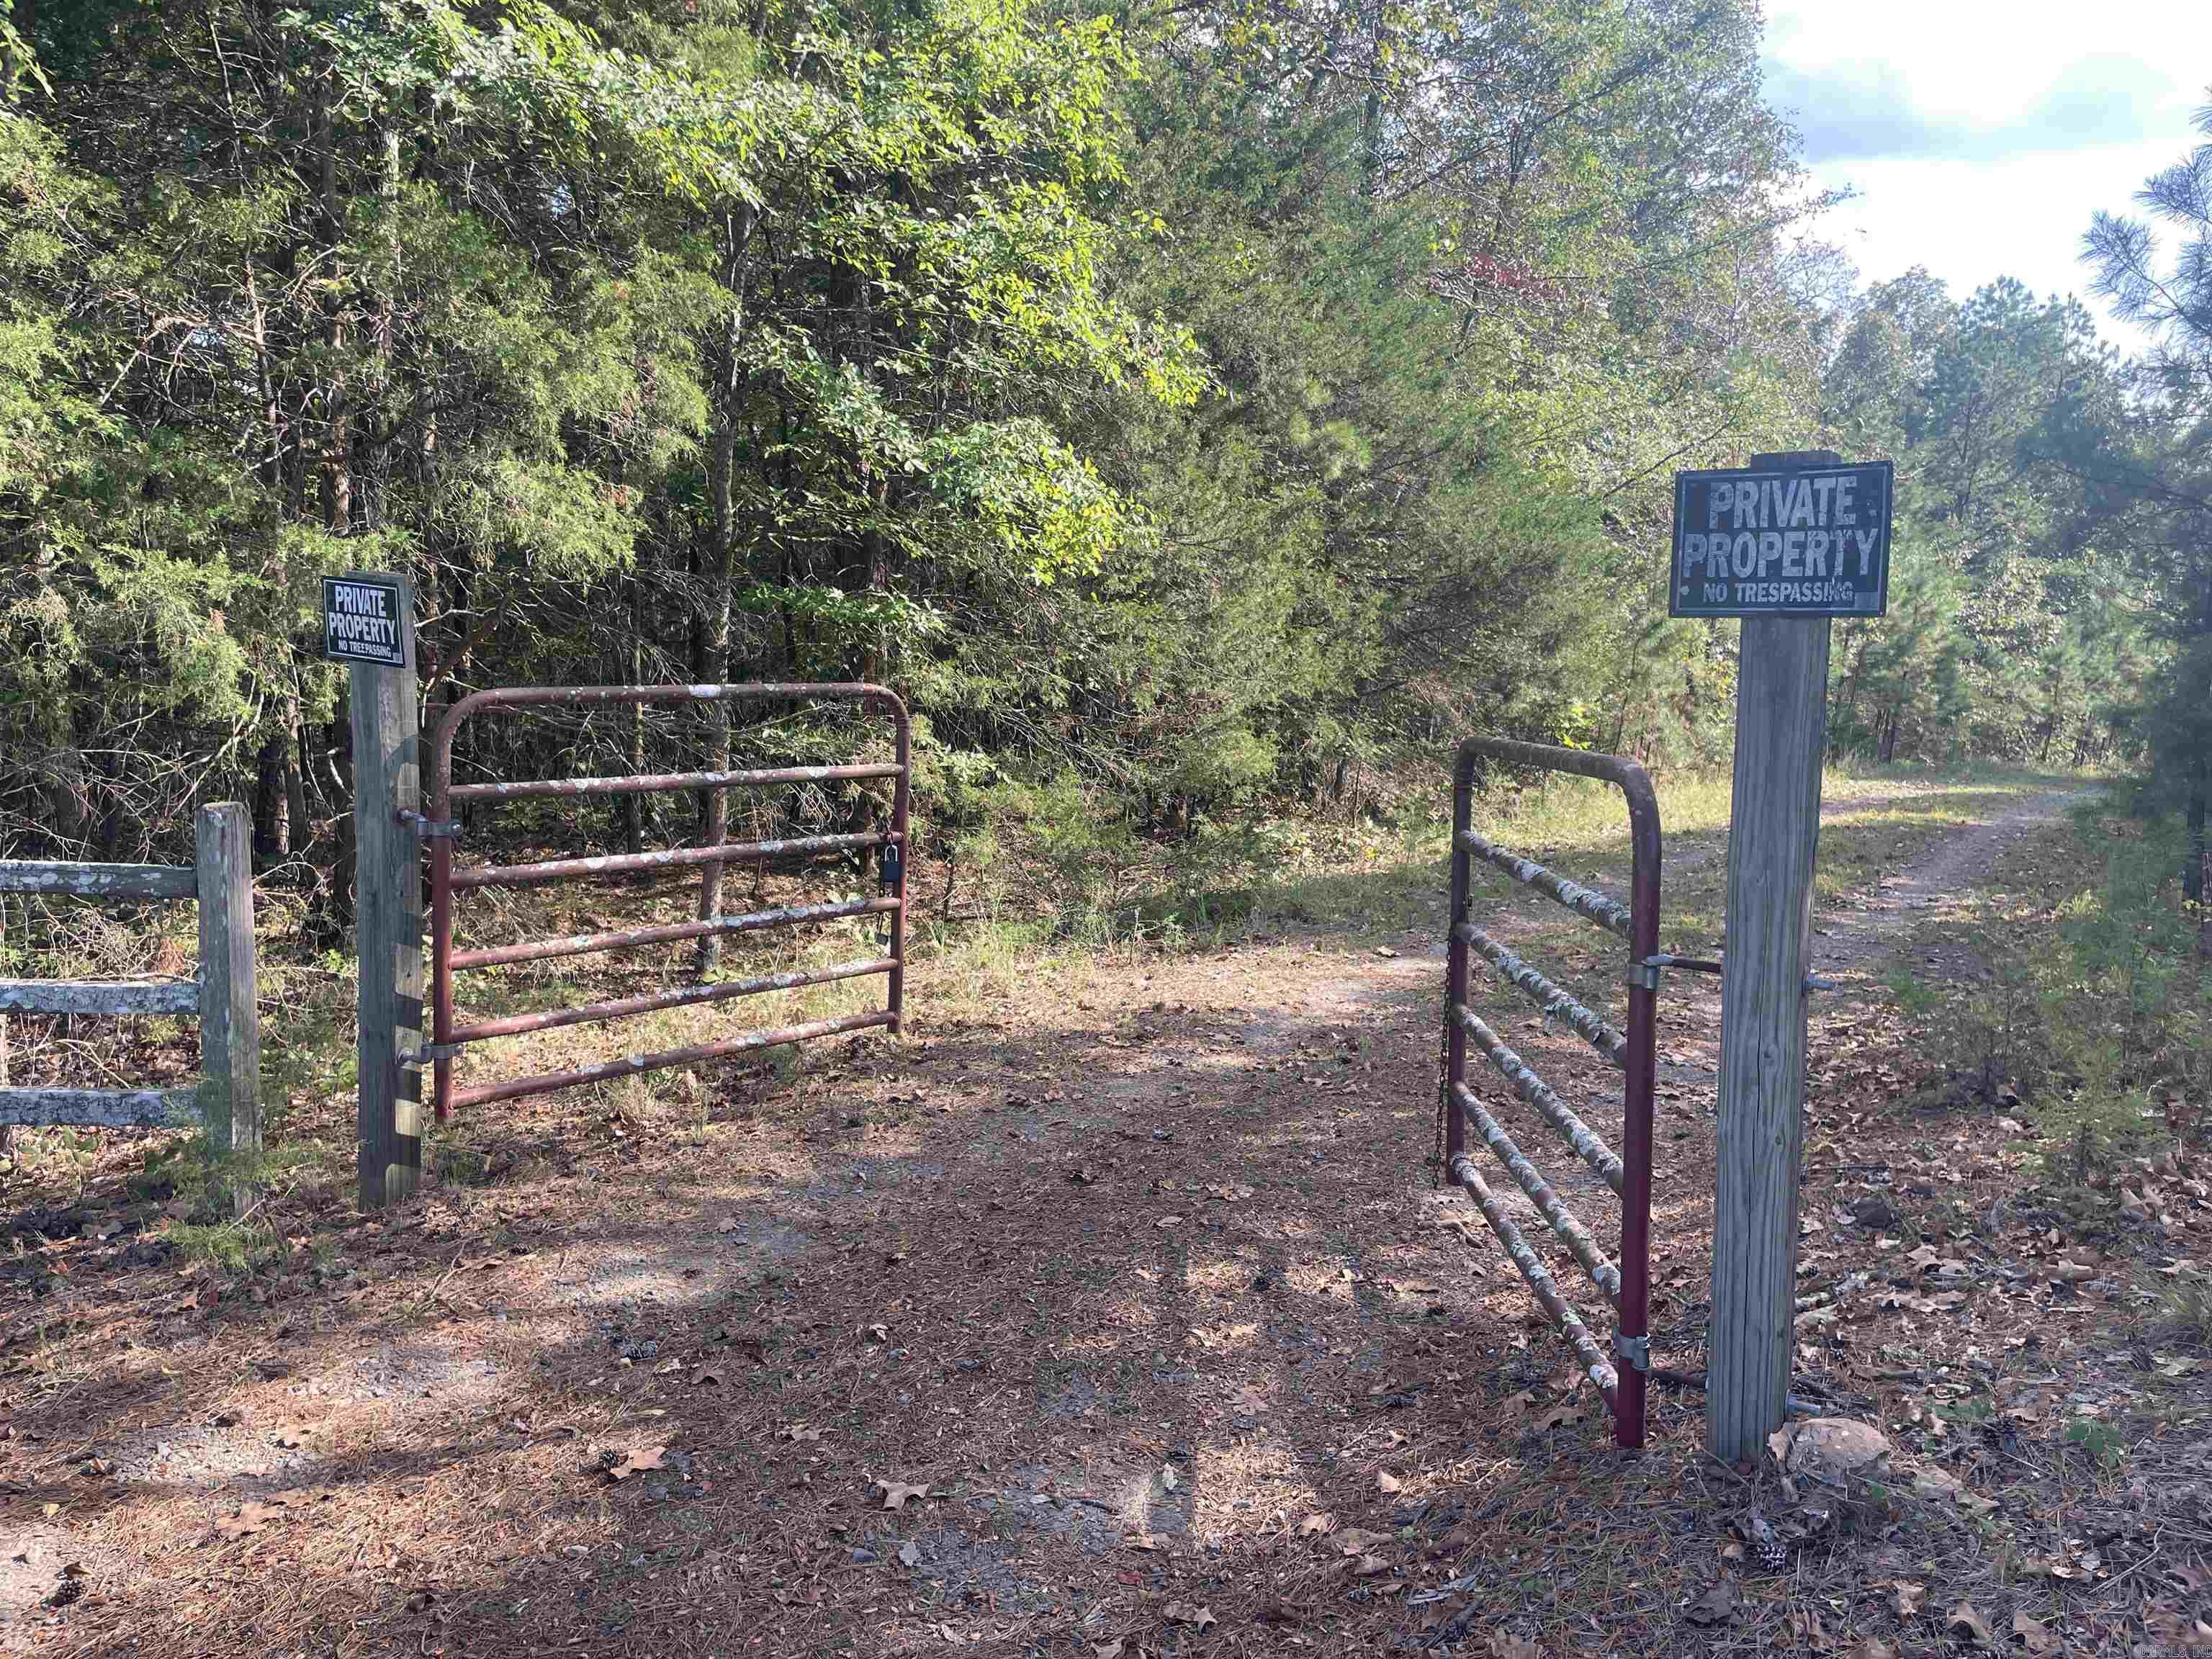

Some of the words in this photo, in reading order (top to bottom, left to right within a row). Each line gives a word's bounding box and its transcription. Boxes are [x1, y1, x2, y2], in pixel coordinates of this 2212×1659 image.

[1709, 476, 1857, 529] PRIVATE
[1681, 528, 1879, 577] PROPERTY
[335, 585, 387, 617] PRIVATE
[1703, 582, 1728, 602] NO
[1735, 576, 1854, 603] TRESPASSING
[328, 611, 396, 645] PROPERTY
[338, 639, 348, 651] NO
